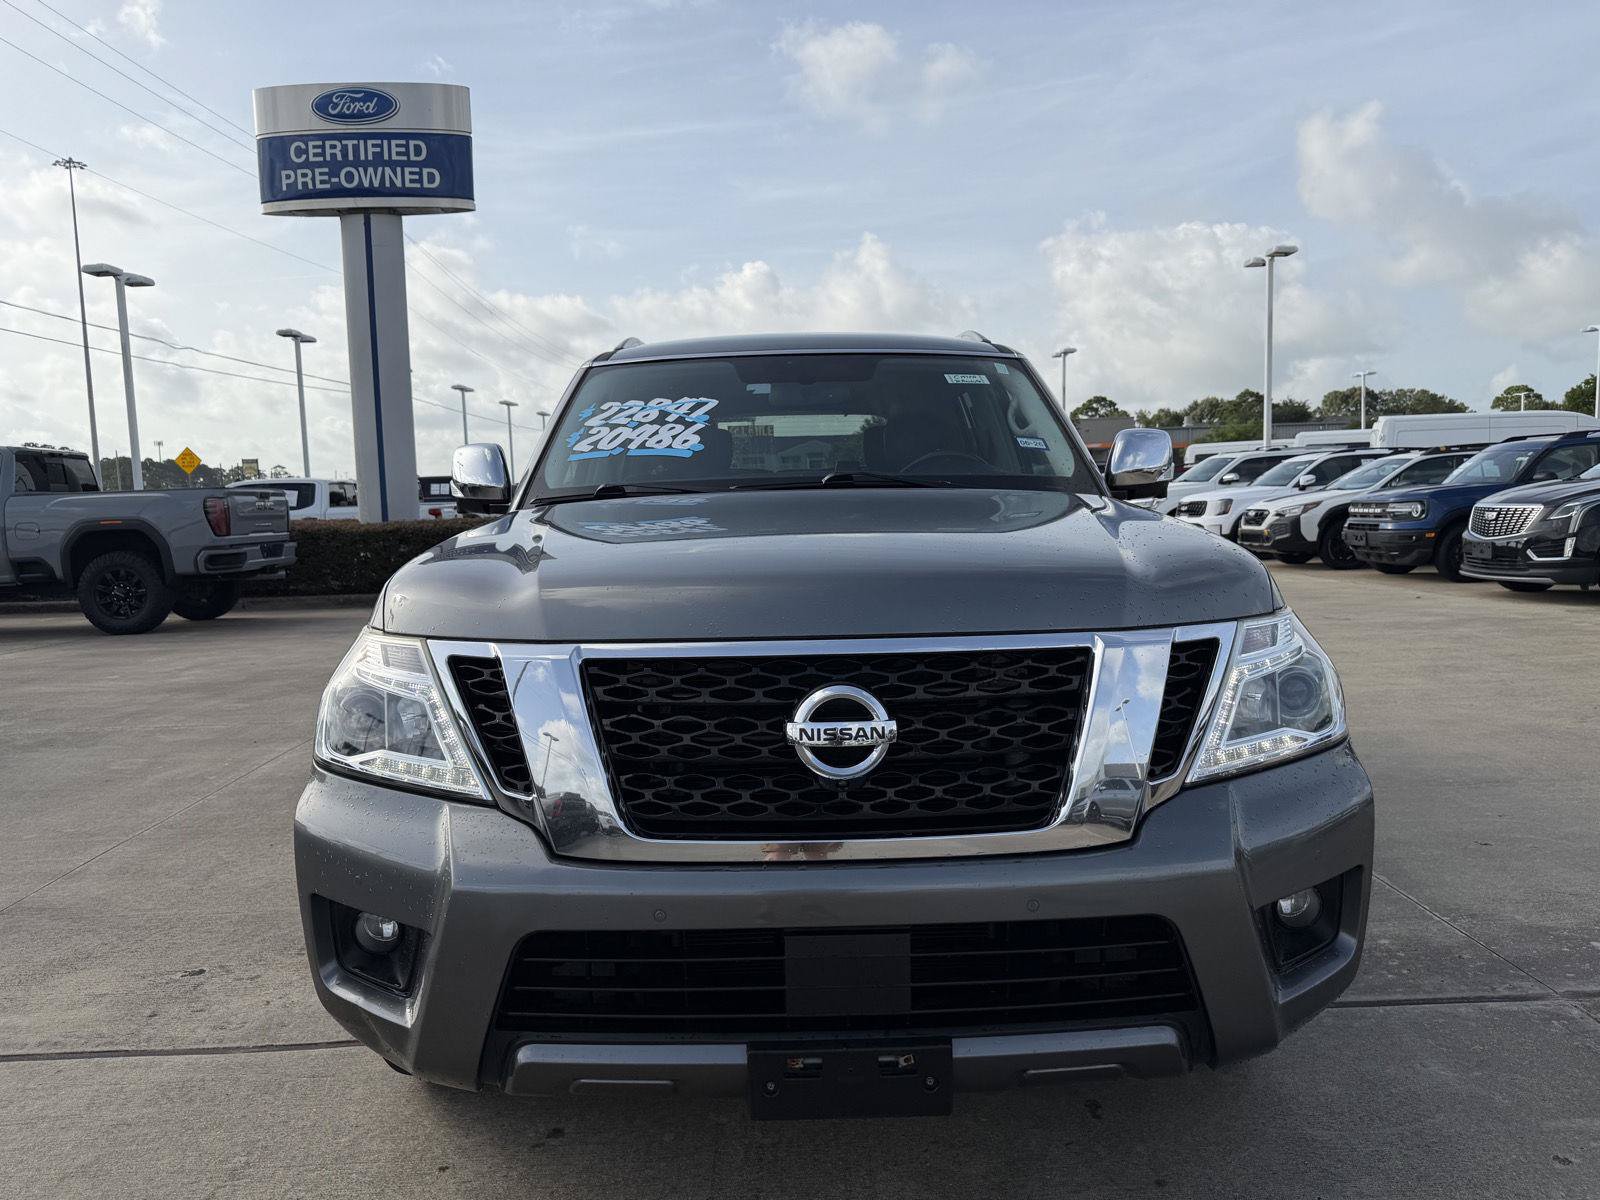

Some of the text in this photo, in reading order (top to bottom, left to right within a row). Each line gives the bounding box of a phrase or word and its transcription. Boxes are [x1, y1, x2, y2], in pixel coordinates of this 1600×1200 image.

[328, 92, 378, 115] Ford
[289, 139, 428, 163] CERTIFIED
[280, 166, 441, 191] PRE-OWNED
[799, 726, 886, 742] NISSAN
